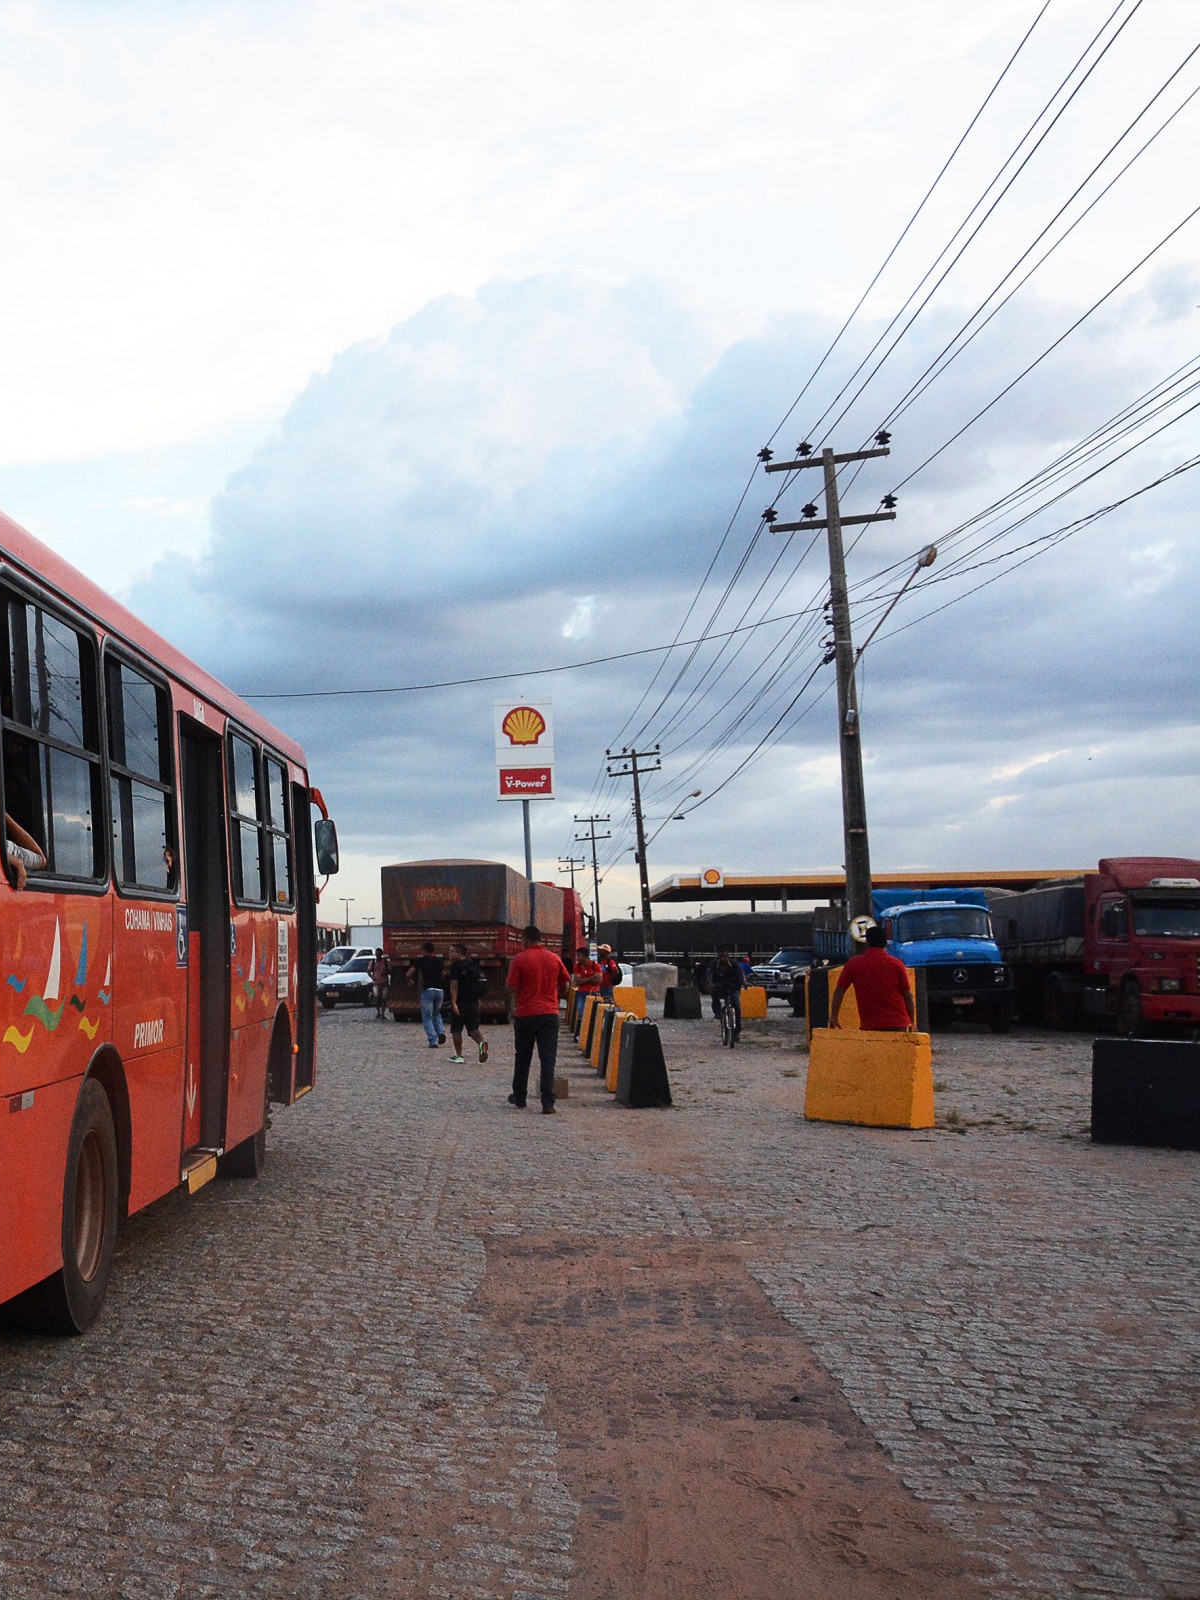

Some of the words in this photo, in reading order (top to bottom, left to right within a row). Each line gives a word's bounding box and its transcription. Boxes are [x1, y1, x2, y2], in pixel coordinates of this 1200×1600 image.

[505, 779, 546, 788] V-Power
[124, 908, 150, 930] COHAMA
[133, 1018, 164, 1049] PRIMOR
